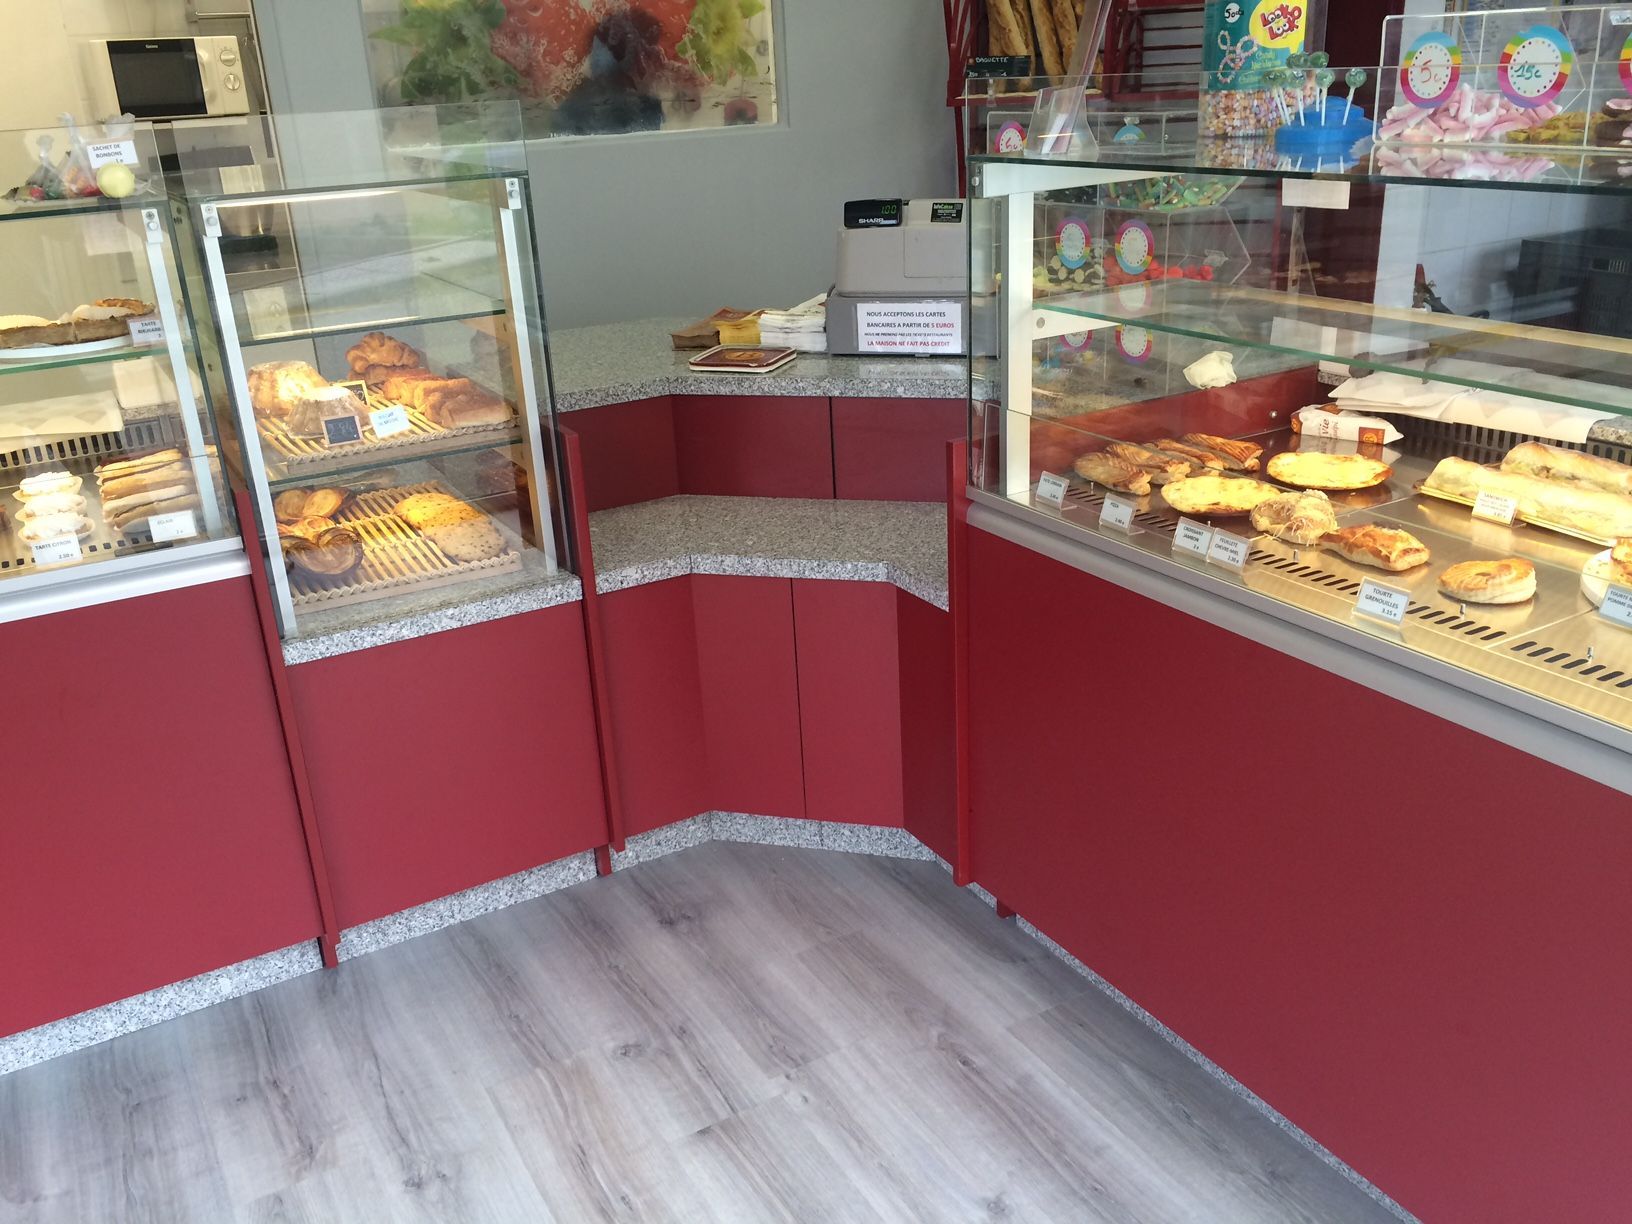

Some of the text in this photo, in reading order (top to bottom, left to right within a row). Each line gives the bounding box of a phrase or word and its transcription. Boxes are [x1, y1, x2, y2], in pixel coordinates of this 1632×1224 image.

[1183, 525, 1204, 536] CROISSANT
[1183, 533, 1199, 543] JAMBON
[1373, 588, 1393, 598] TOURTE
[1365, 594, 1399, 609] GRENOUILLES
[1607, 597, 1626, 607] POMME
